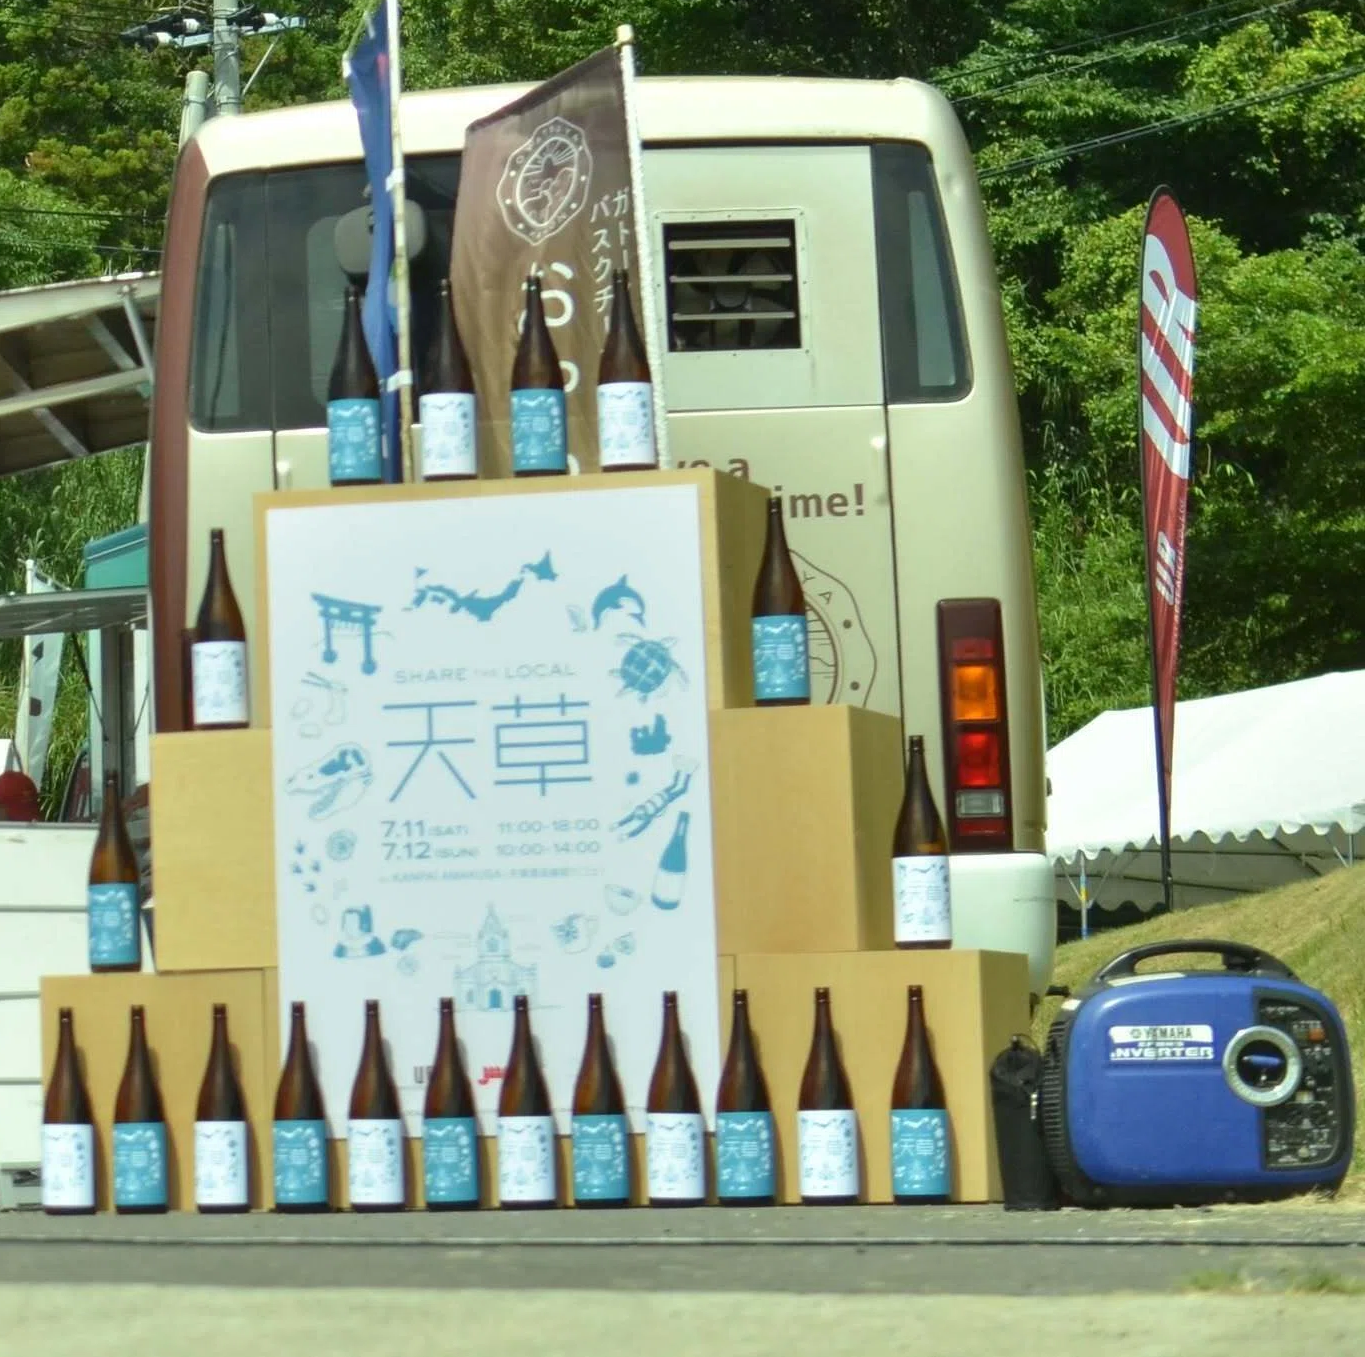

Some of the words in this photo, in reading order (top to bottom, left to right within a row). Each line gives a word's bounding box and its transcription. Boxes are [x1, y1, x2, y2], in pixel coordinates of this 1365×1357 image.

[773, 484, 865, 518] me!
[394, 667, 468, 685] SHARE
[504, 662, 577, 679] LOCAL
[382, 692, 593, 803] 天草
[381, 819, 426, 838] 7.11
[381, 841, 431, 861] 7.12
[1145, 1027, 1192, 1039] YAMAHA
